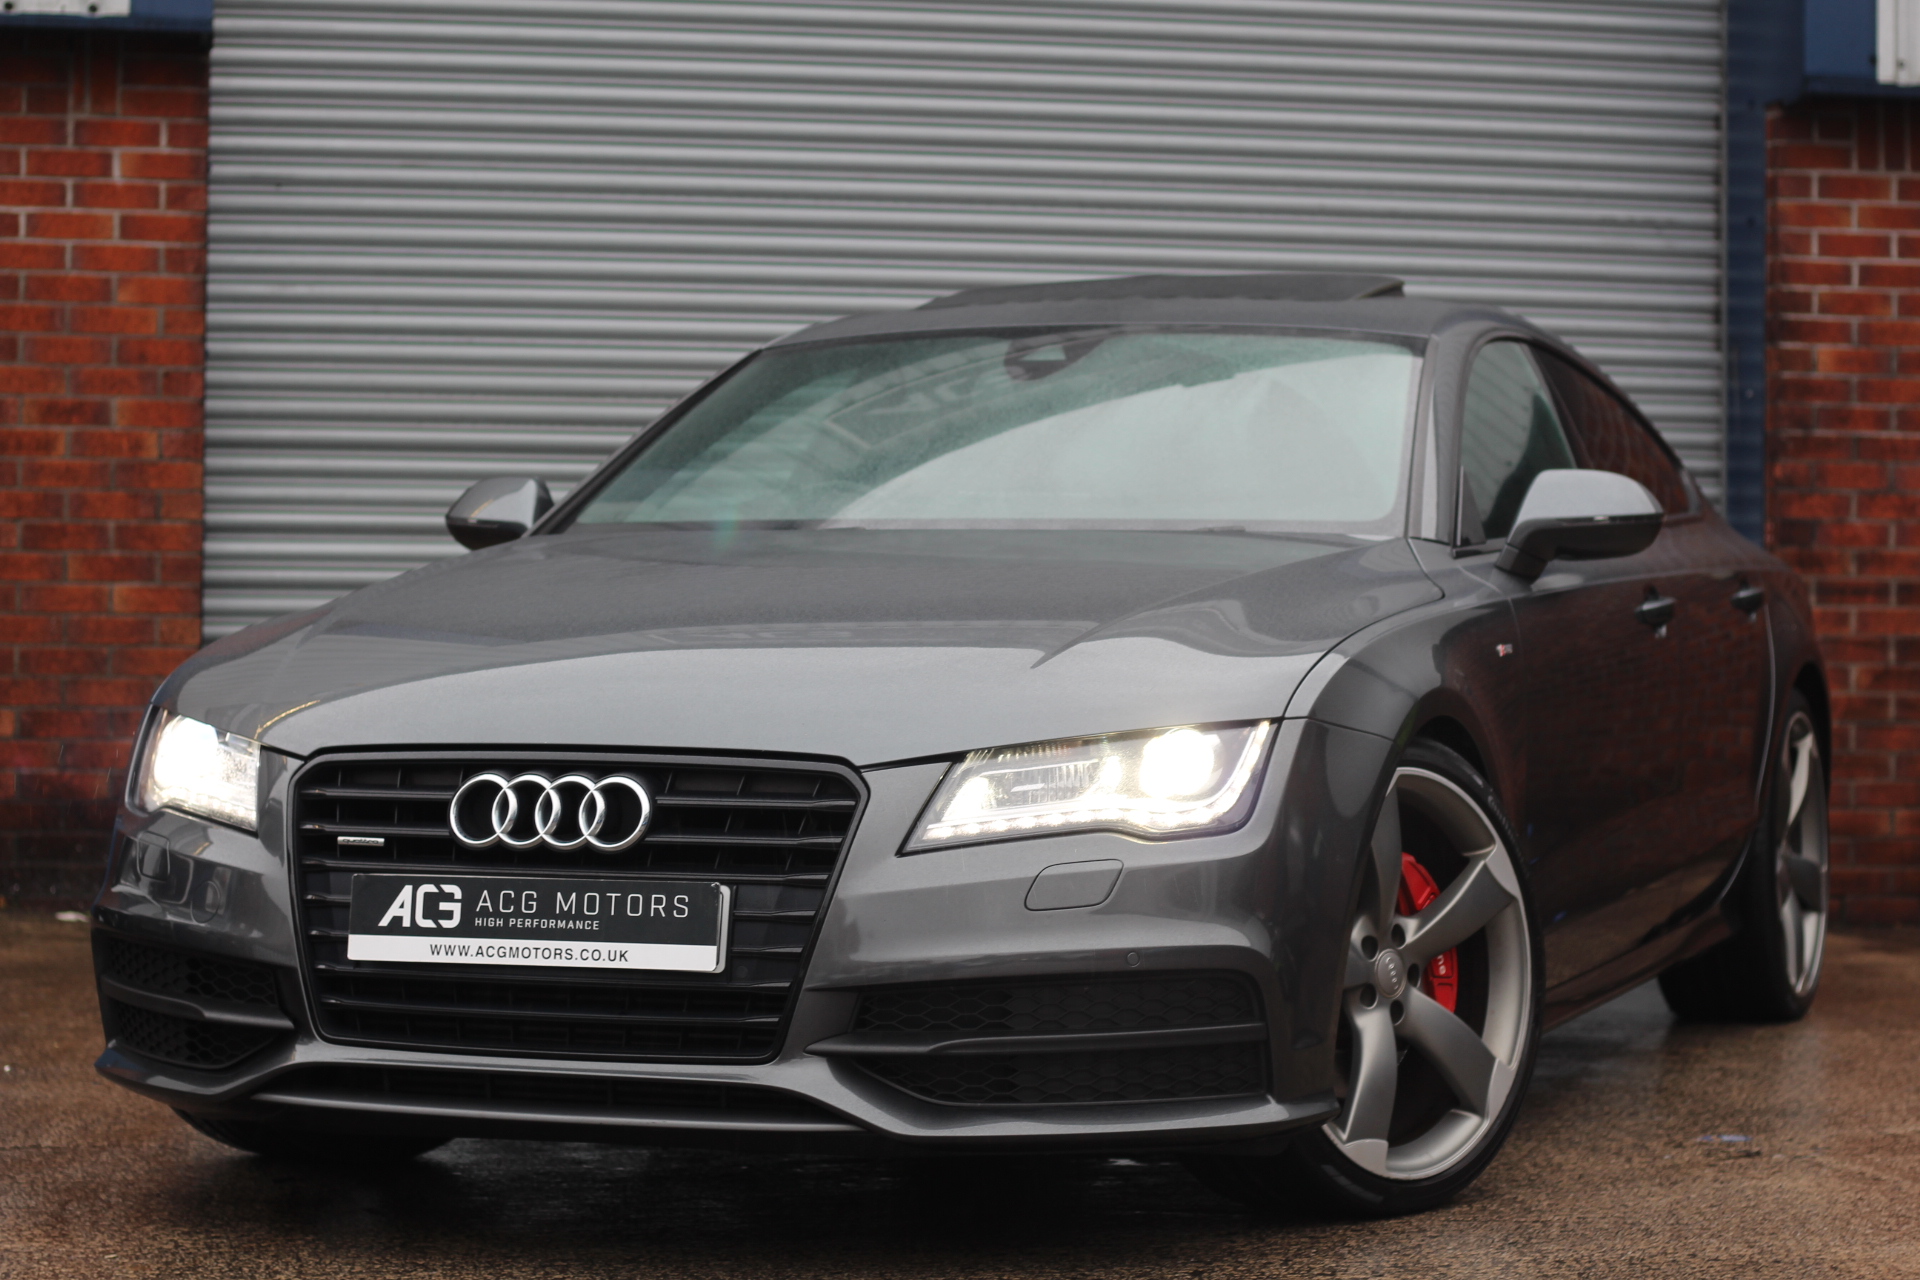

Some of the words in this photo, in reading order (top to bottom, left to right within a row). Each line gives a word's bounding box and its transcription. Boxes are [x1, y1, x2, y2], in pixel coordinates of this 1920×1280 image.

[378, 884, 462, 928] ACG
[476, 889, 537, 914] ACG
[556, 892, 689, 918] MOTORS
[475, 917, 503, 927] HIGH
[509, 918, 600, 930] PERFORMANCE
[430, 944, 629, 962] WWW.ACGMOTORS.CO.UK
